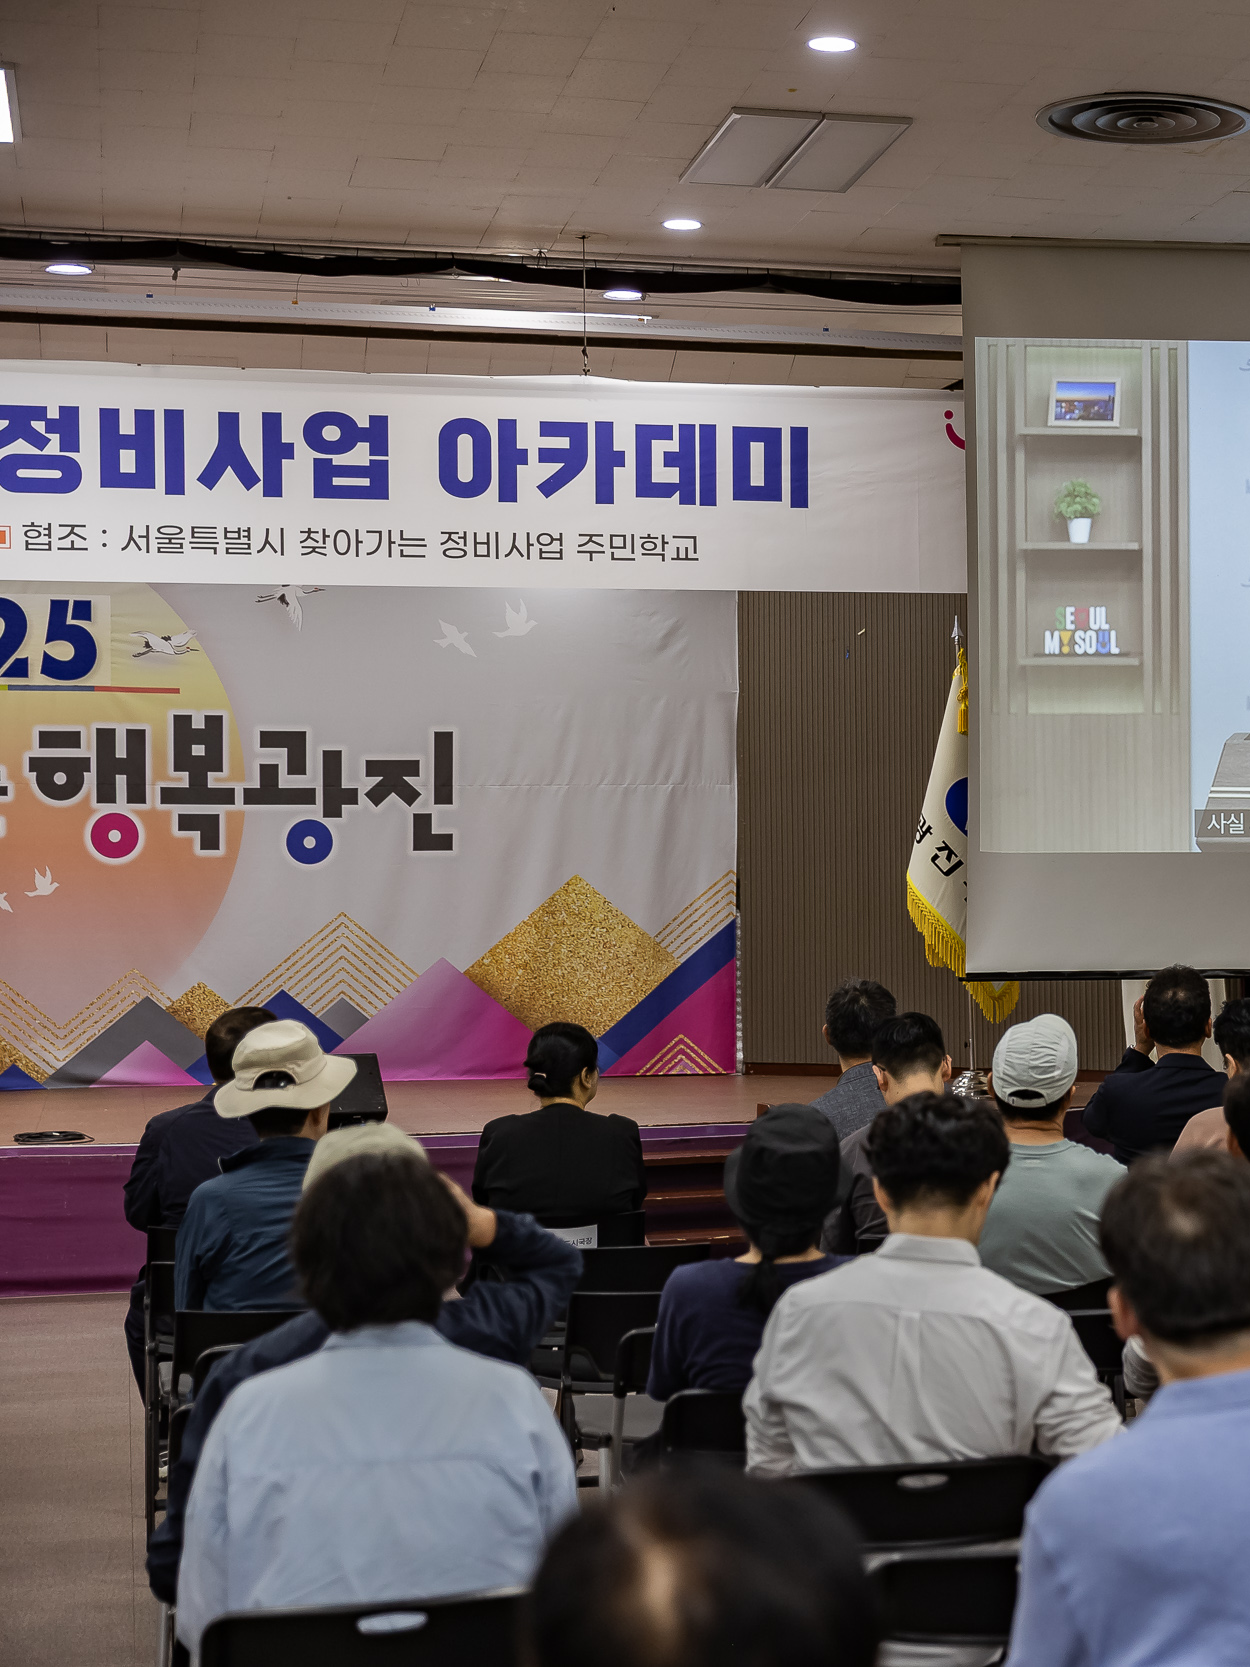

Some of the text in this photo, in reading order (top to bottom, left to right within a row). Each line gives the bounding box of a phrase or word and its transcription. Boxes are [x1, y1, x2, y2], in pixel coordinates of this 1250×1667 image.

[0, 404, 809, 509] 정비사업 아카데미
[22, 521, 89, 551] 협조
[120, 524, 286, 557] 서울특별시
[299, 527, 428, 558] 찾아가는
[439, 530, 565, 561] 정비사업
[576, 532, 700, 563] 주민학교
[1055, 606, 1110, 630] SEOUL
[1074, 630, 1121, 655] SOUL
[28, 713, 454, 865] 행복광진
[1207, 812, 1245, 835] 사실
